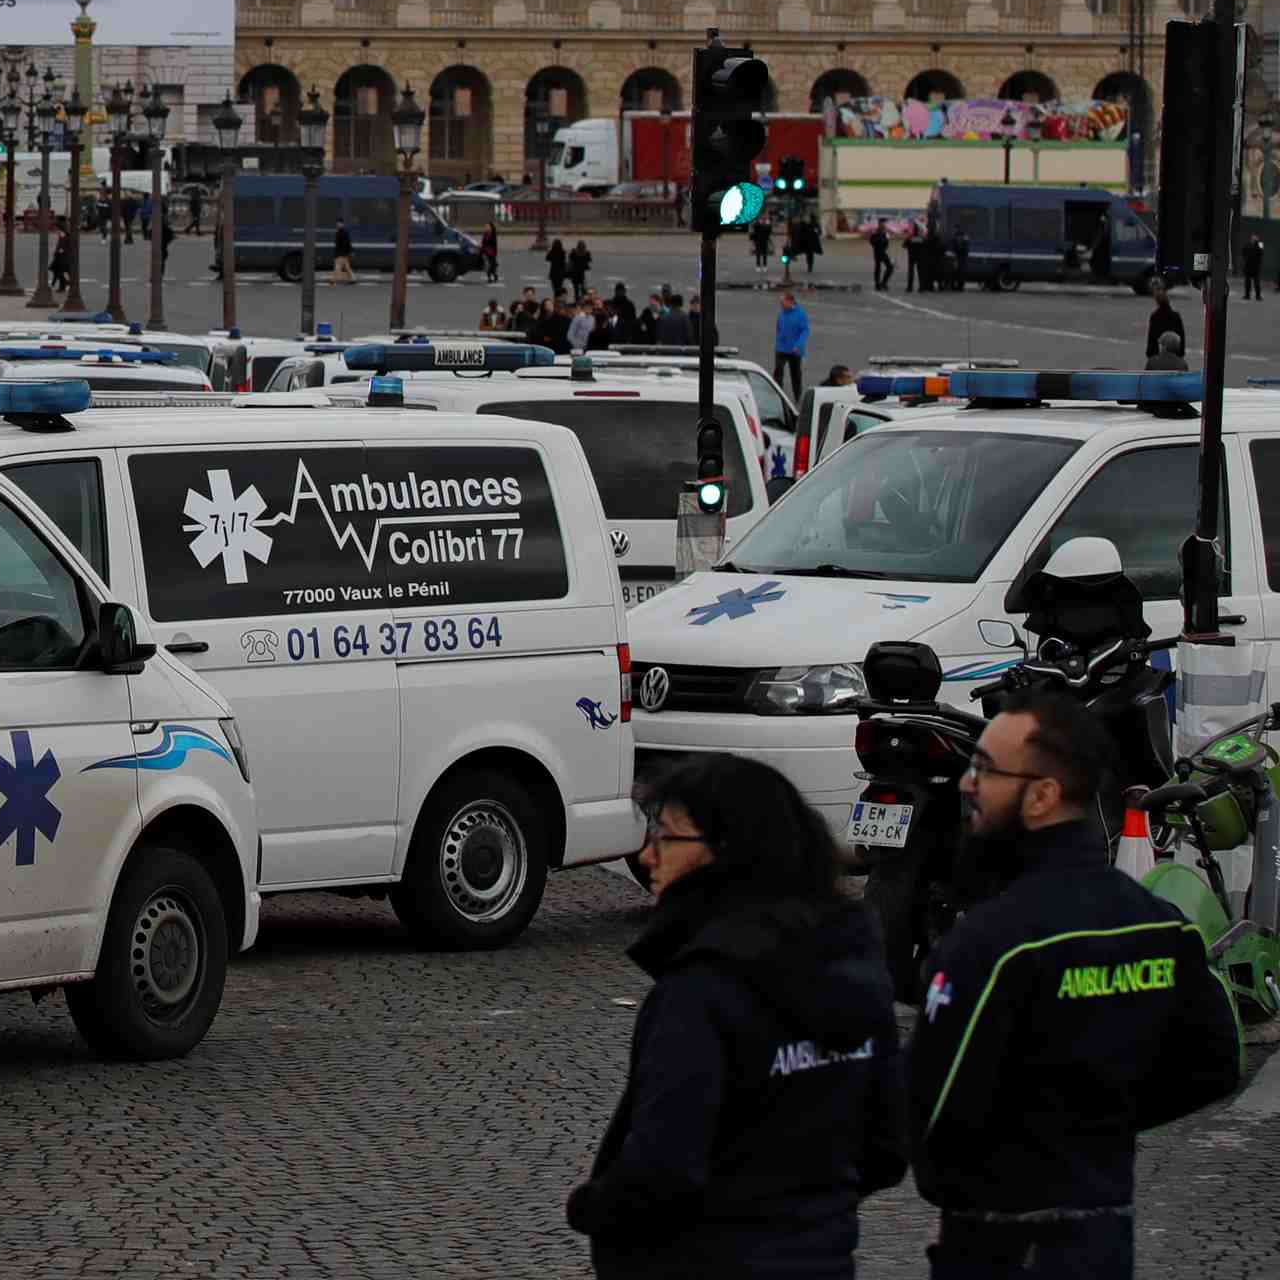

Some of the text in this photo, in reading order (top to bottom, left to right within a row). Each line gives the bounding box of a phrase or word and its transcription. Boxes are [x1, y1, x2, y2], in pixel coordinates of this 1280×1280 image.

[435, 349, 483, 365] AMBULANCE
[292, 458, 523, 532] Ambulances
[388, 526, 525, 566] Colibri 77
[283, 580, 451, 606] 77000 Vaux le Pénil
[287, 616, 503, 662] 01 64 37 83 64
[1057, 957, 1176, 999] AMBULANCIER
